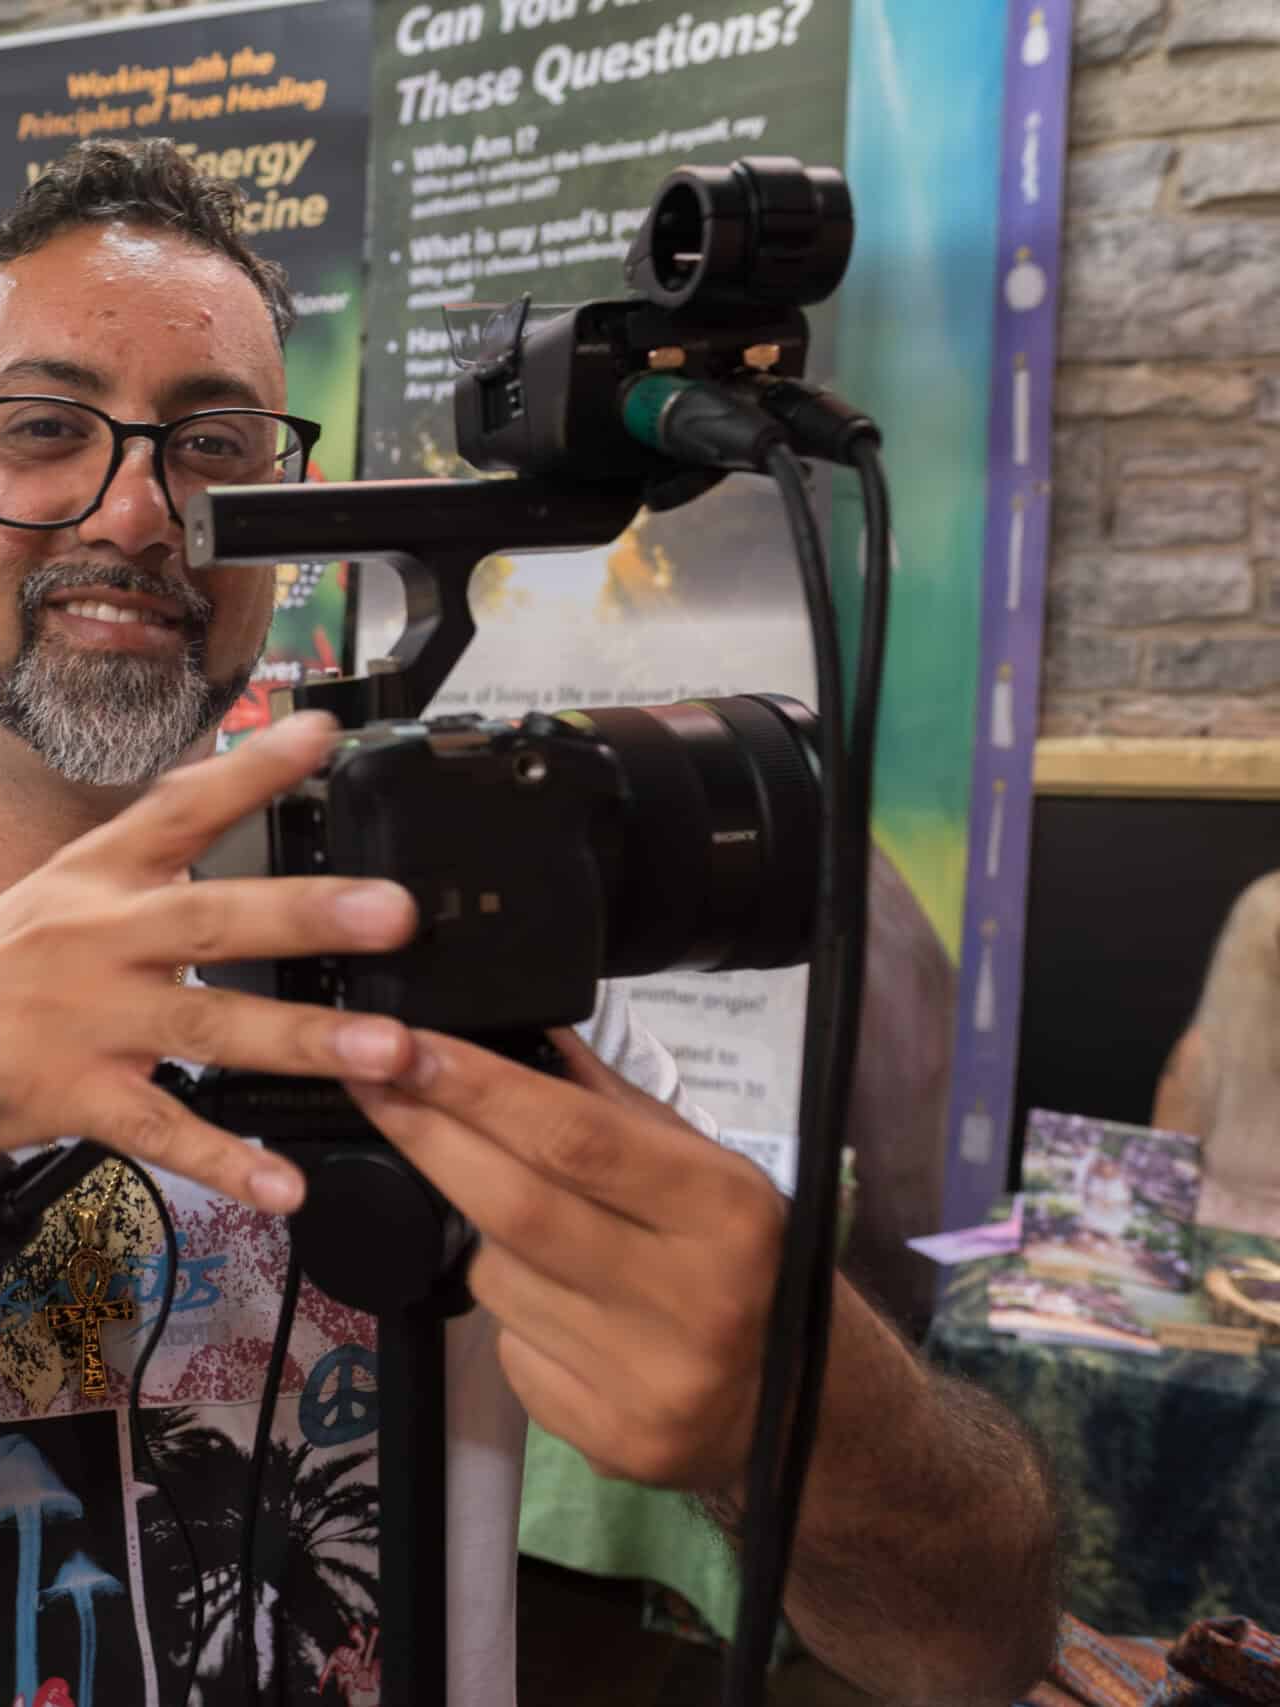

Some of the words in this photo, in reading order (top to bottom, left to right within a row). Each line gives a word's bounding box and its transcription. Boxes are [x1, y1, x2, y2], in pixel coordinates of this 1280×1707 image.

[396, 4, 483, 56] Can
[500, 0, 575, 33] You
[67, 64, 170, 99] Working
[172, 51, 228, 85] with
[230, 47, 276, 77] the
[396, 68, 523, 125] These
[533, 0, 812, 104] Questions?
[17, 103, 132, 141] Principles
[135, 92, 168, 126] of
[169, 93, 225, 121] True
[225, 76, 327, 112] Healing
[412, 143, 467, 171] Who
[470, 134, 512, 163] Am
[515, 125, 540, 154] I?
[223, 191, 329, 236] cine
[410, 232, 472, 262] What
[474, 226, 496, 252] is
[497, 225, 537, 255] my
[540, 209, 608, 244] soul's
[250, 656, 302, 684] ives
[712, 830, 758, 844] SONY
